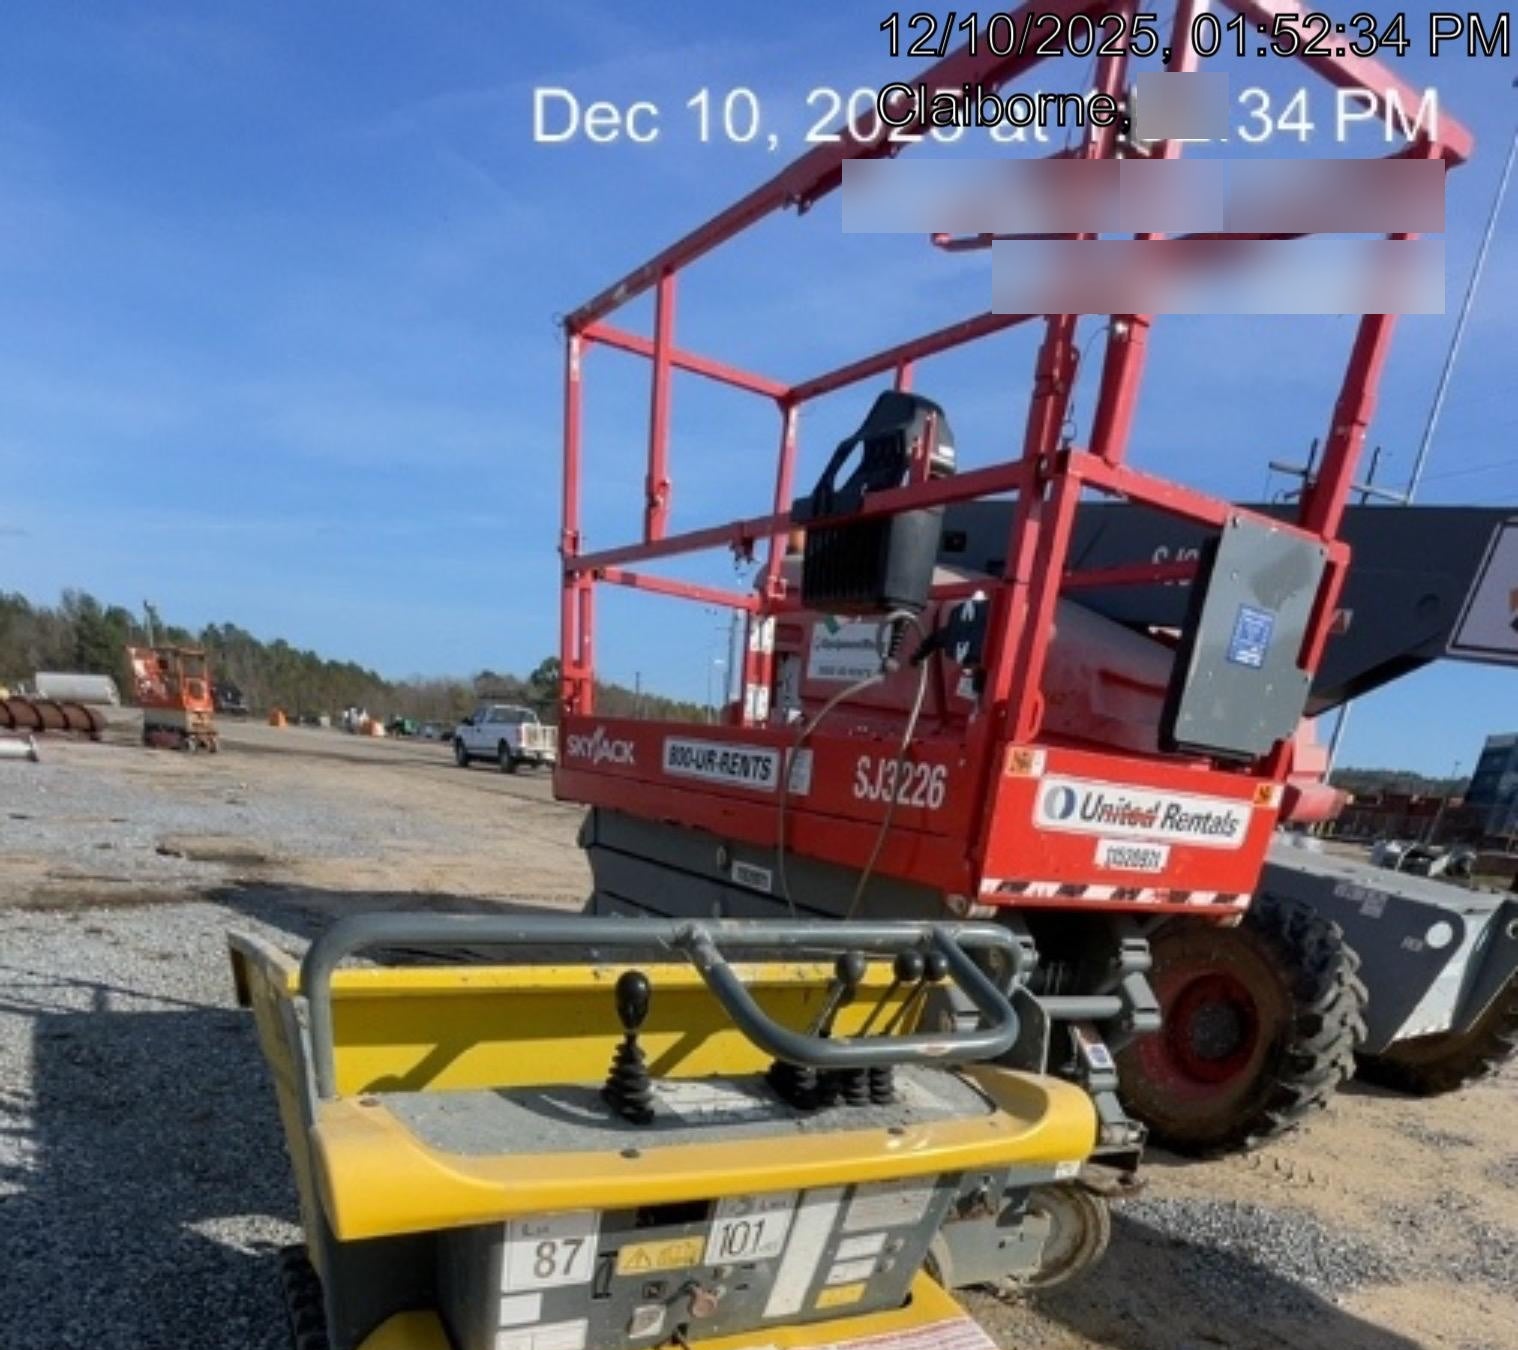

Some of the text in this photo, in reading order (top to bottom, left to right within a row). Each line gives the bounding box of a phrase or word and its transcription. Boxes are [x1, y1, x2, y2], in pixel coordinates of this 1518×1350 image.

[565, 731, 636, 766] SKYJACK
[668, 742, 773, 782] 800-UR-RENTS
[853, 755, 948, 811] SJ3226
[1079, 791, 1242, 839] United Rentals
[533, 1237, 585, 1279] 87
[719, 1217, 766, 1258] 101
